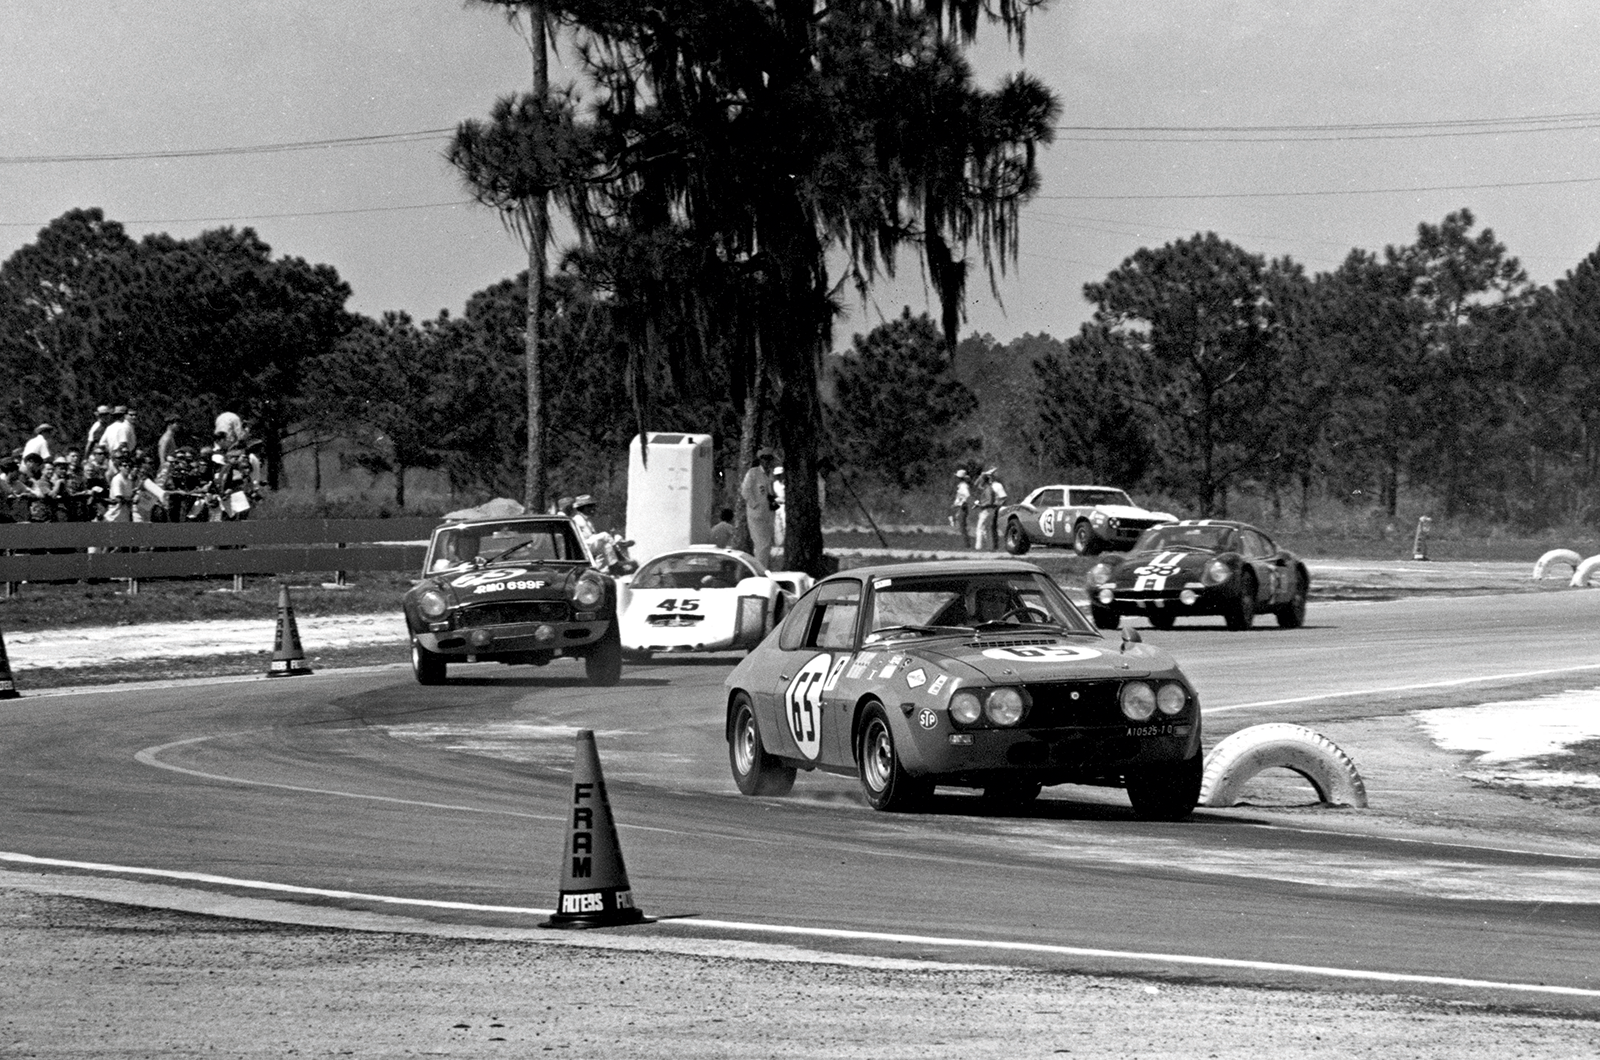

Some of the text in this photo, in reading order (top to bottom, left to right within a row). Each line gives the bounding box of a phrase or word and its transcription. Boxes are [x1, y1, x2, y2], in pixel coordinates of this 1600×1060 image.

[506, 580, 545, 590] 699F
[656, 598, 700, 611] 45
[1001, 646, 1080, 657] 65
[791, 672, 823, 742] 65
[920, 710, 935, 727] STP
[572, 783, 593, 878] FRAM
